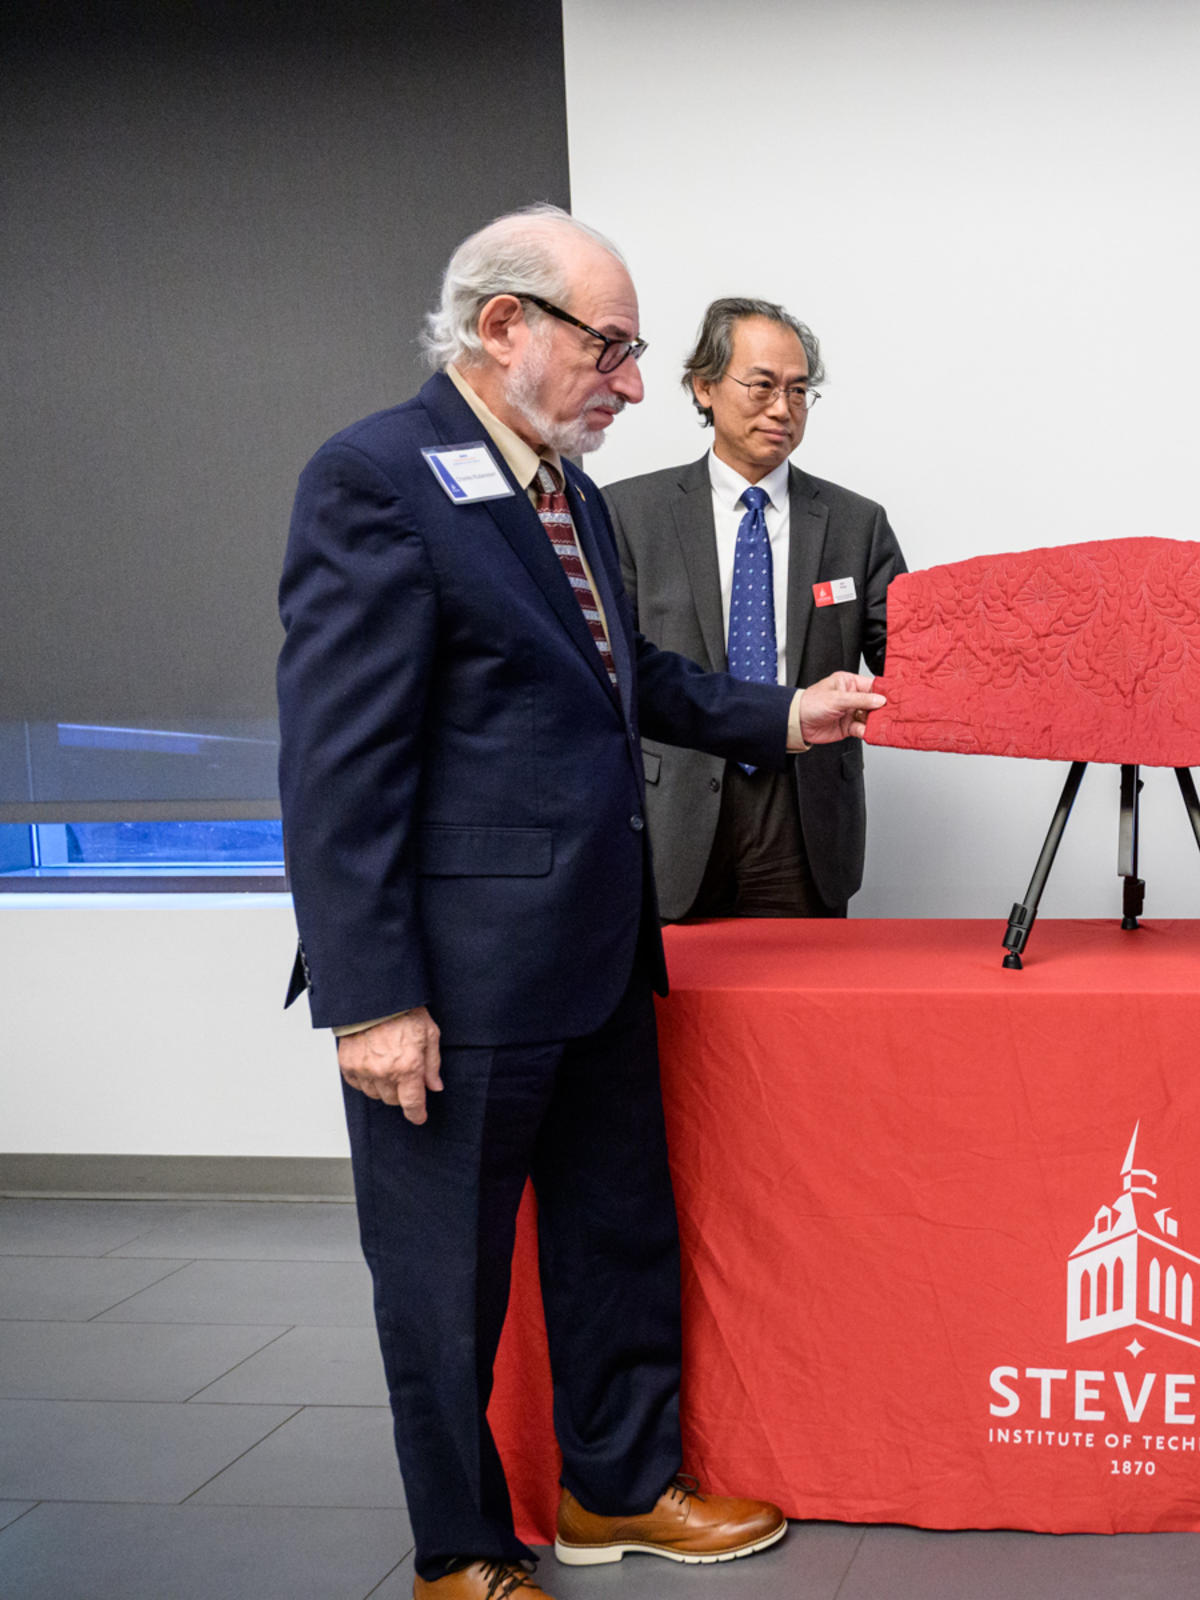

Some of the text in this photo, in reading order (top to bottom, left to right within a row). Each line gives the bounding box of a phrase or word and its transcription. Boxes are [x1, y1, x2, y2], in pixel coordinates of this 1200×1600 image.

[989, 1428, 1095, 1448] INSTITUTE
[1104, 1433, 1132, 1449] OF
[1111, 1459, 1156, 1476] 1870
